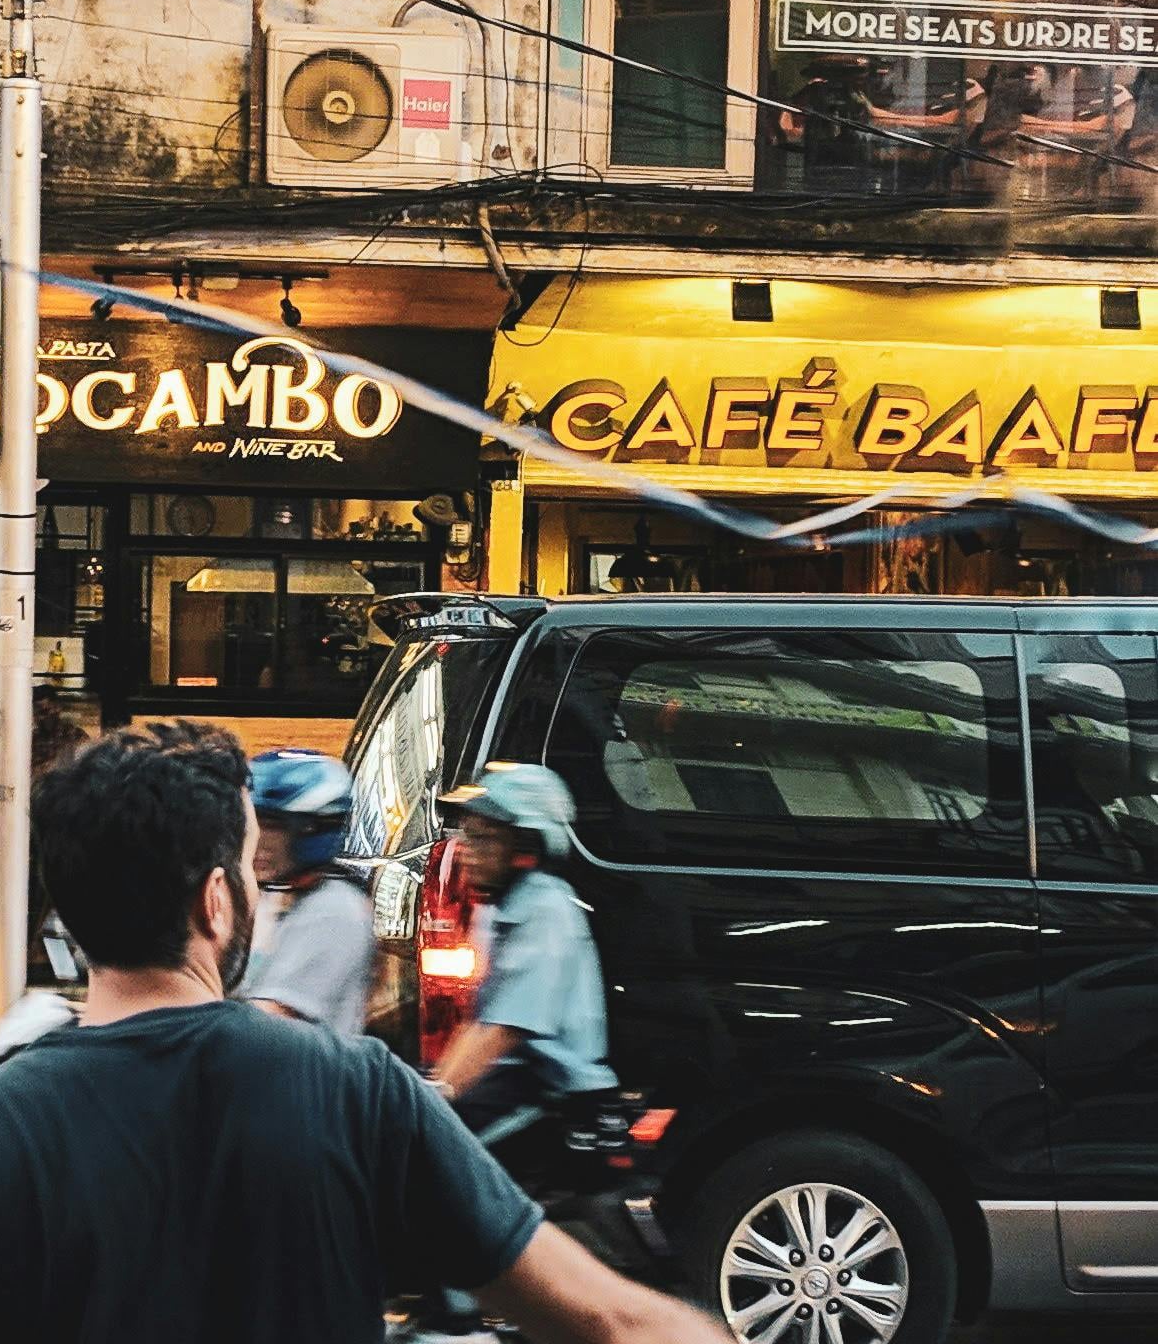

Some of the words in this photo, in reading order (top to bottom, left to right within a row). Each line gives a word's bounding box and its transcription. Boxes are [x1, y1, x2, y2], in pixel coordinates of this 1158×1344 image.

[805, 9, 897, 40] MORE
[904, 15, 995, 48] SEATS
[1117, 24, 1158, 53] SE
[404, 95, 450, 112] Haier
[49, 340, 116, 358] PASTA
[542, 357, 839, 455] CAFÉ
[192, 441, 226, 453] AND
[17, 595, 25, 620] 1
